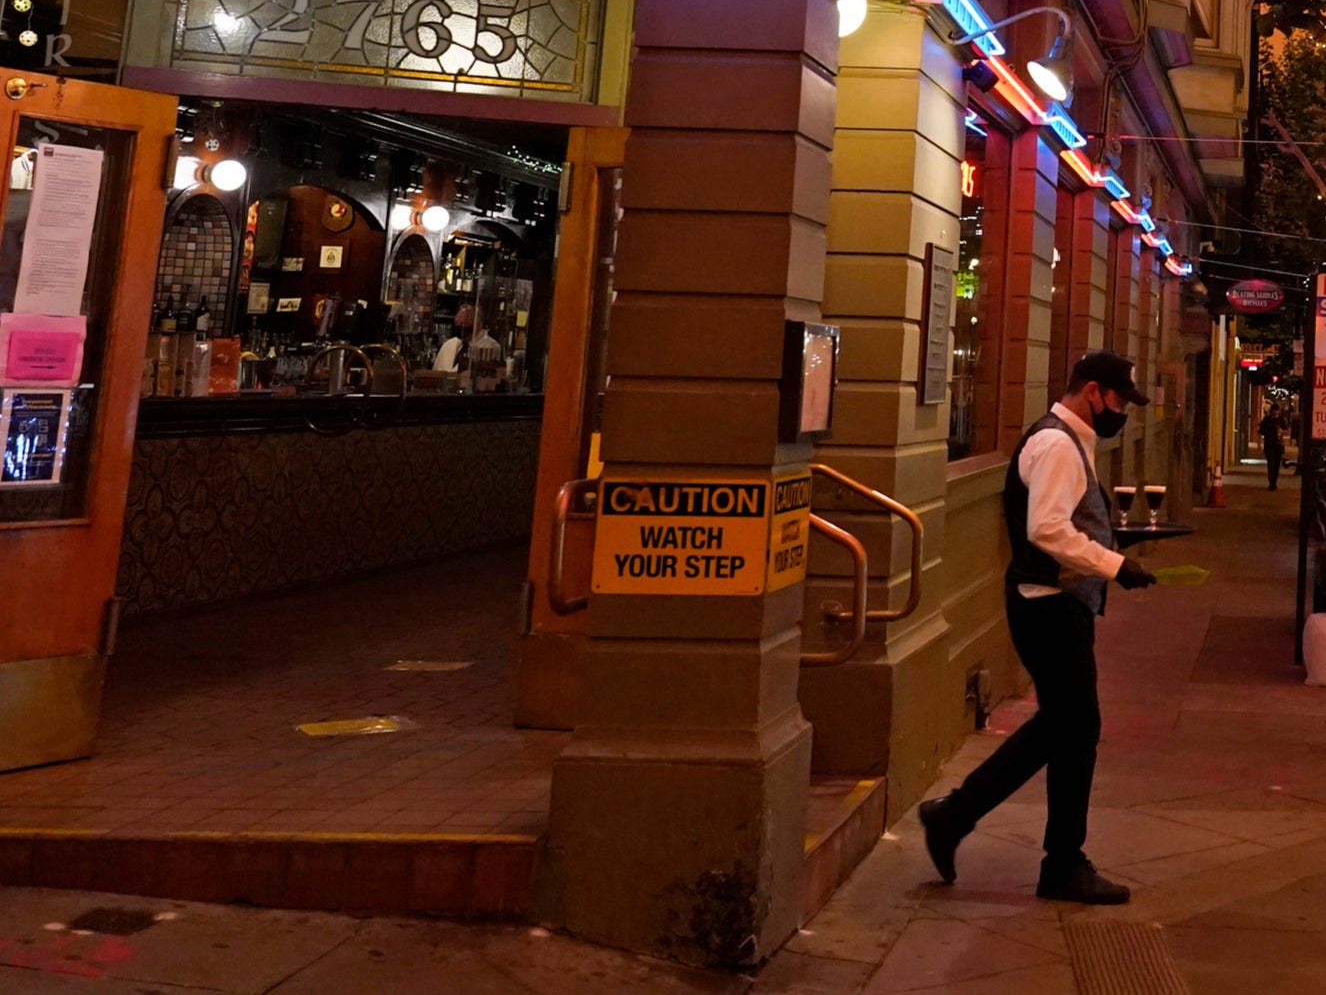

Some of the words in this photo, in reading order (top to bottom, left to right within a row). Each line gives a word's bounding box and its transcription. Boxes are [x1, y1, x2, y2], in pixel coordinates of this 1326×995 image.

[610, 486, 760, 514] CAUTION
[640, 526, 724, 550] WATCH
[614, 554, 678, 578] YOUR
[684, 555, 746, 579] STEP
